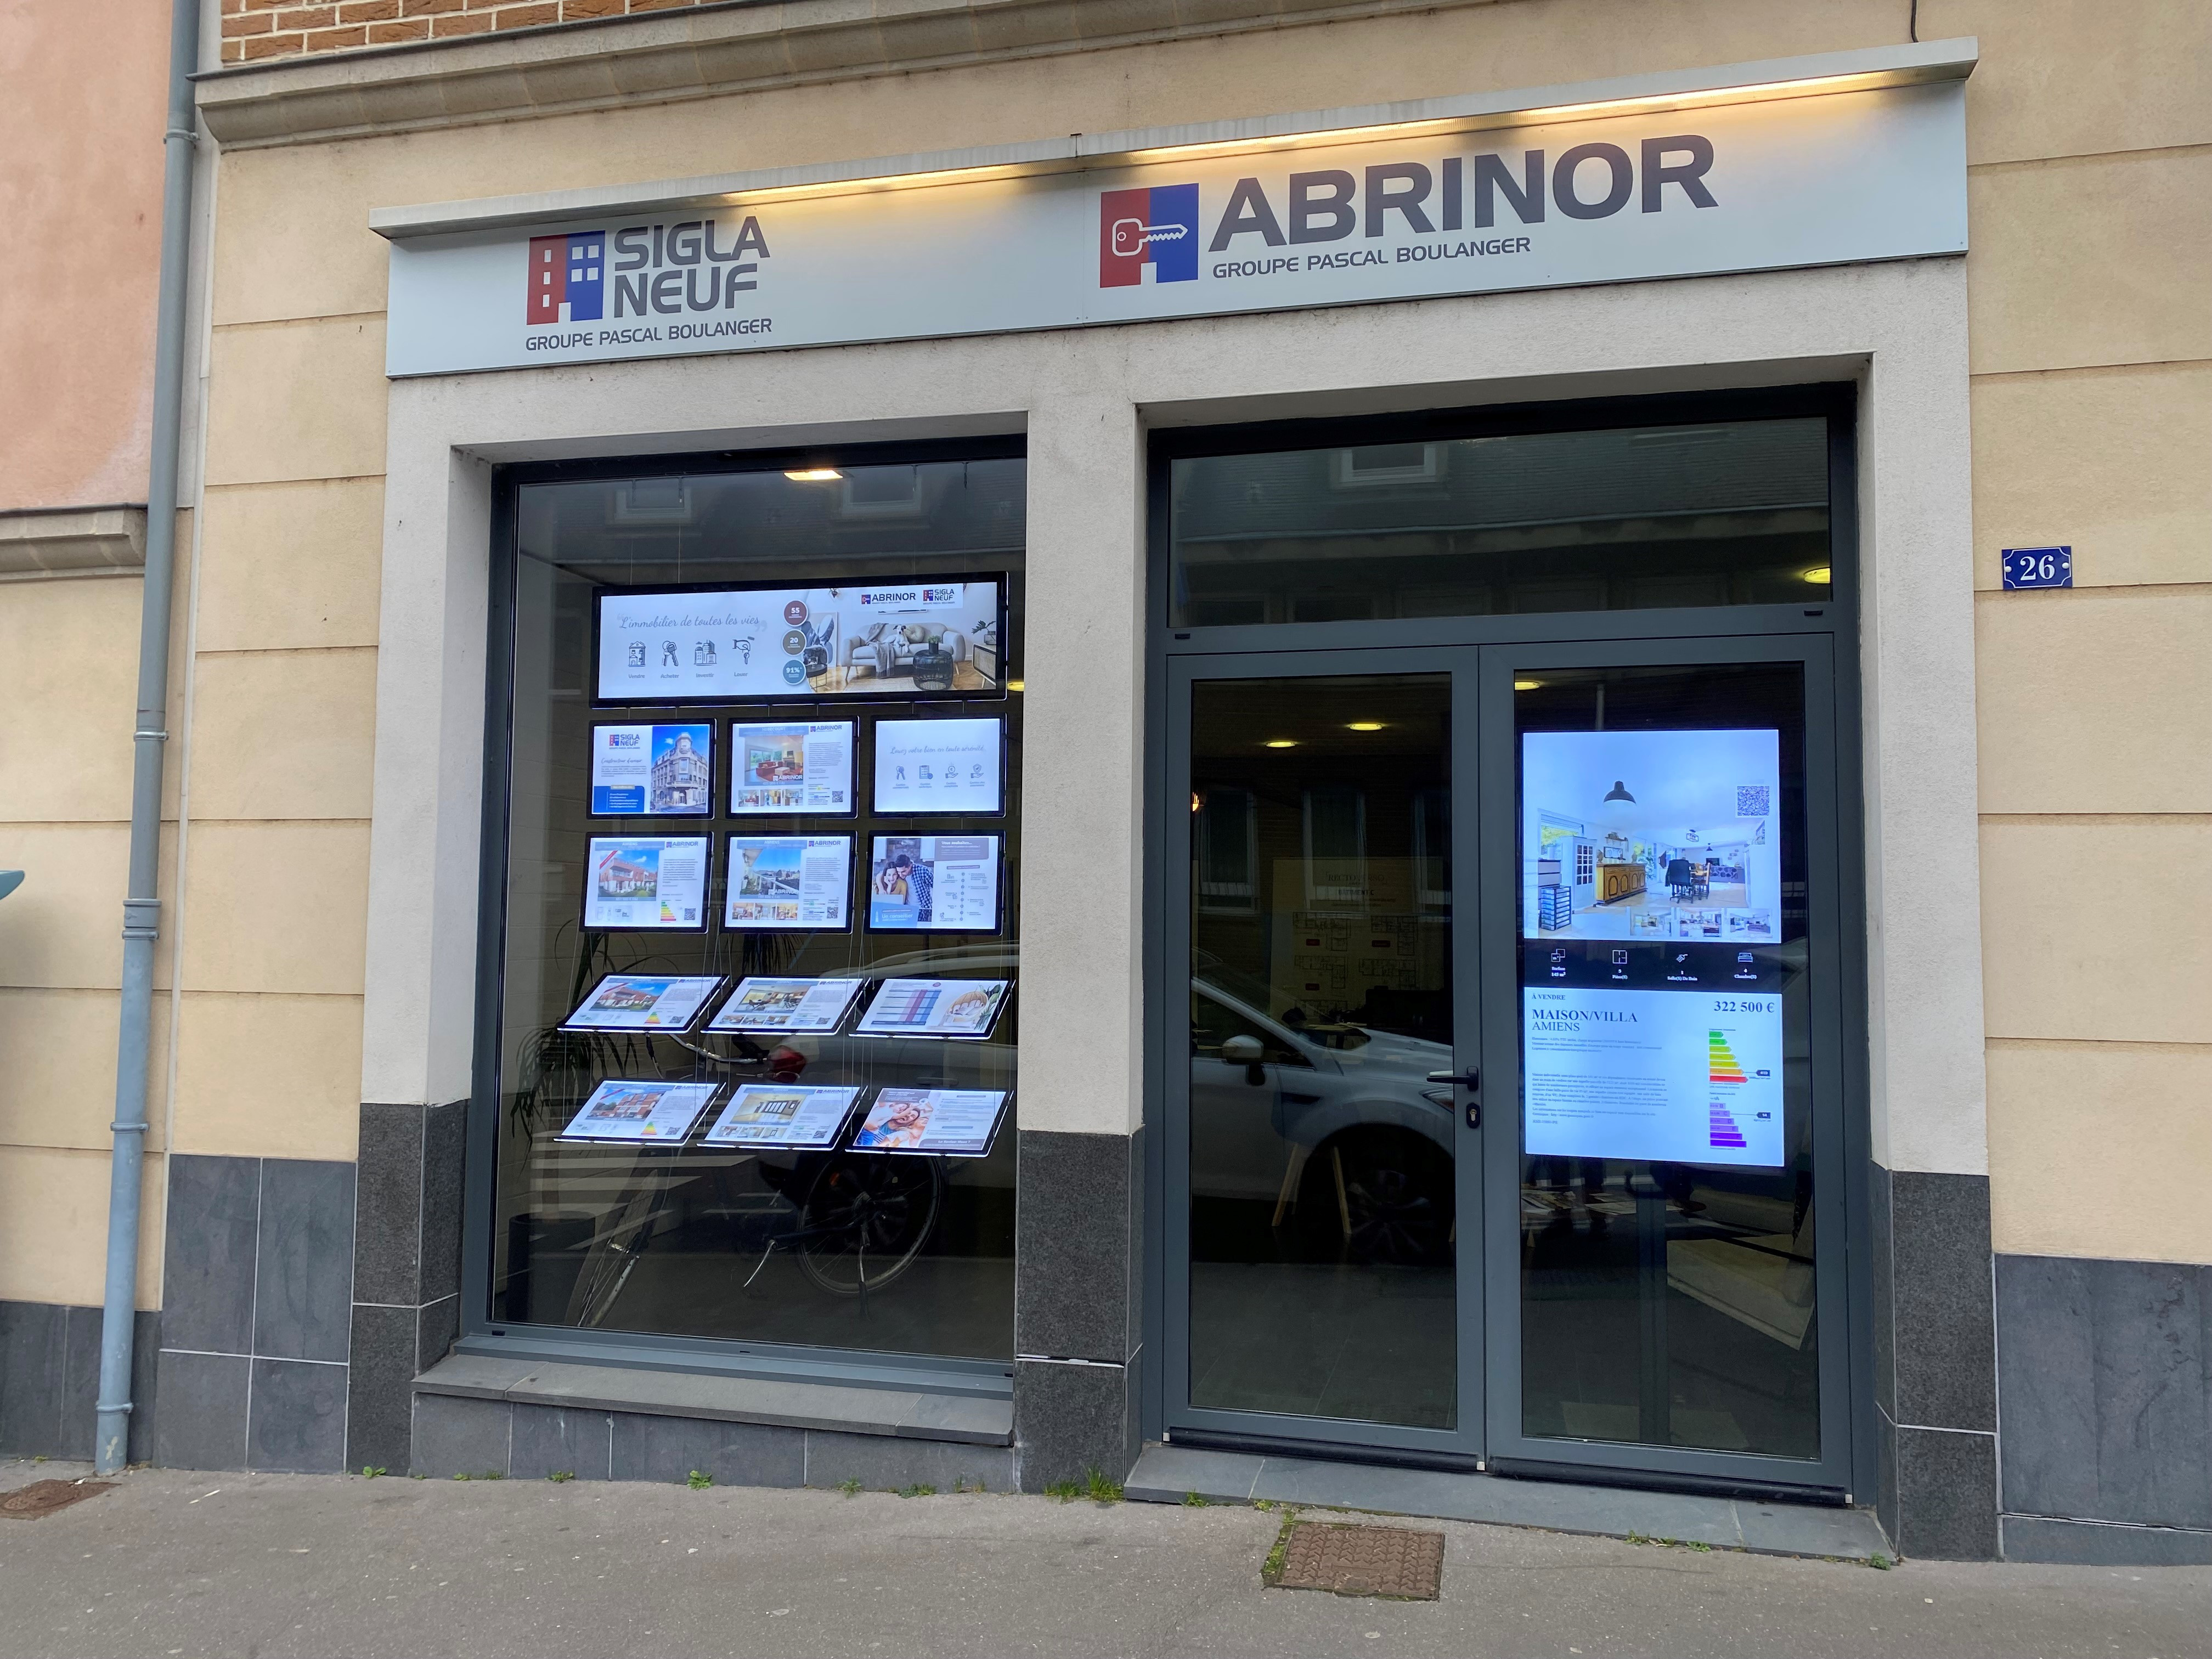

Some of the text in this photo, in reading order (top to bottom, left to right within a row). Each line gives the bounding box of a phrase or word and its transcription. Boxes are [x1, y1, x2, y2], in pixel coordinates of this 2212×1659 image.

[1208, 134, 1719, 252] ABRINOR
[614, 216, 770, 272] SIGLA
[1213, 237, 1531, 279] GROUPE PASCAL BOULANGER
[614, 263, 757, 318] NEUF
[526, 318, 772, 351] GROUPE PASCAL BOULANGER
[2020, 555, 2055, 580] 26
[871, 592, 916, 601] ABRINOR
[619, 613, 760, 629] L'immobilier de toutes les vies
[1532, 1009, 1638, 1022] MAISON/VILLA
[1714, 1001, 1775, 1013] 322 500 €
[1532, 1022, 1580, 1031] AMIENS
